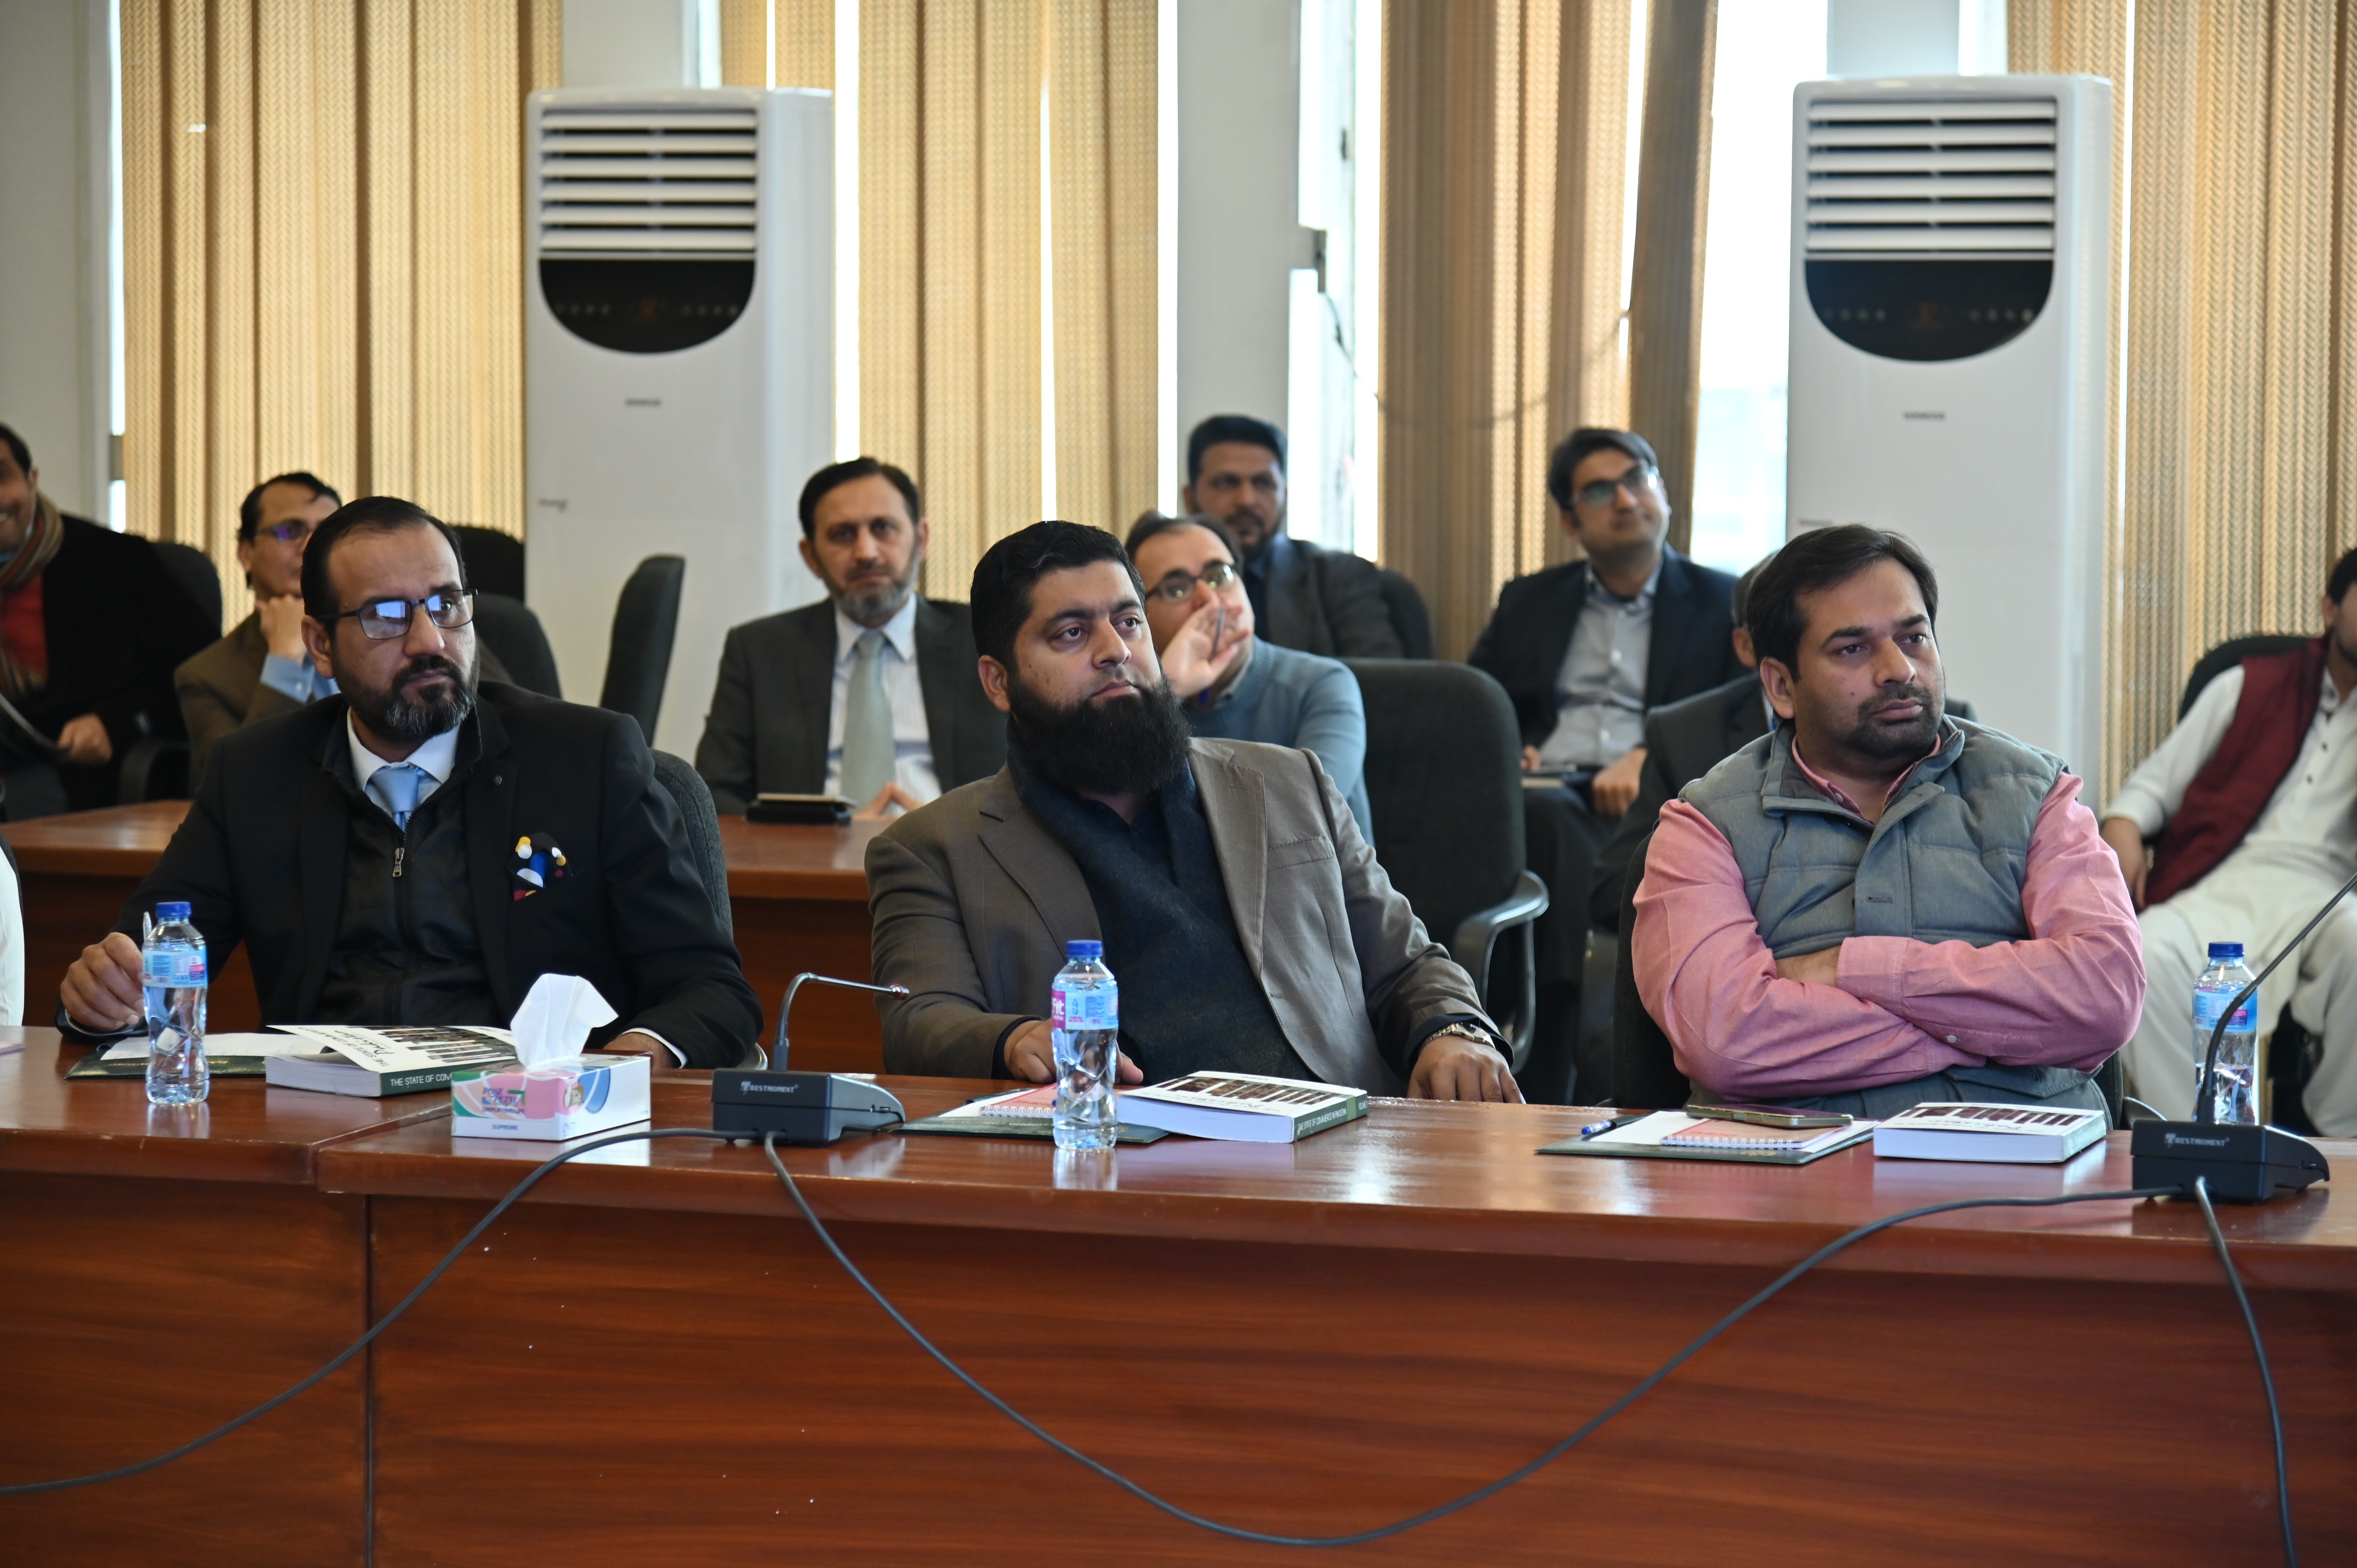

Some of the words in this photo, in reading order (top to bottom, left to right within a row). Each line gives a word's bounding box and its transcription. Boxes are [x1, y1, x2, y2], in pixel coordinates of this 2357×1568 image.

[390, 1078, 404, 1086] THE
[405, 1075, 424, 1085] STATE
[425, 1074, 435, 1083] OF
